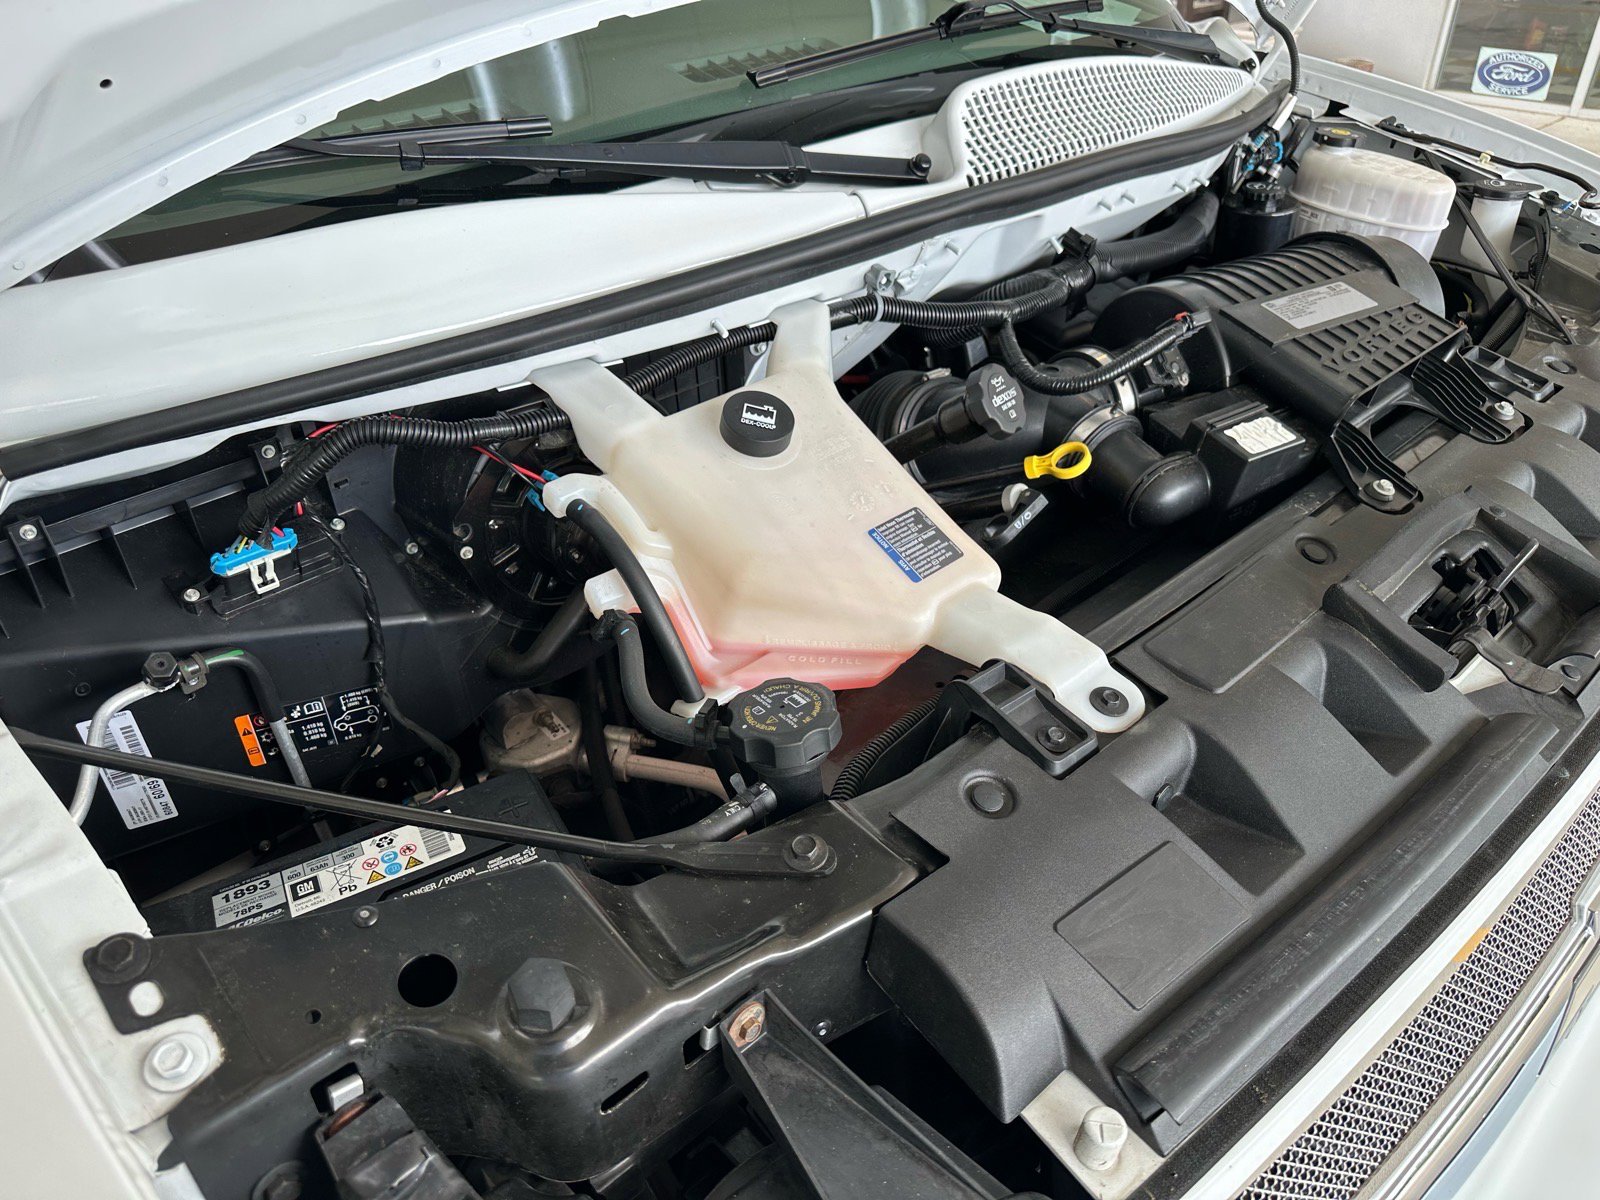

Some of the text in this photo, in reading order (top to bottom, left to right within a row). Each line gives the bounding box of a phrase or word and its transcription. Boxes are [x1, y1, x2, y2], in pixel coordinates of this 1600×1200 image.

[1488, 52, 1544, 70] AUTHORIZED
[1491, 64, 1534, 82] Ford
[1488, 82, 1529, 95] SERVICE
[1321, 308, 1427, 375] VORTEC
[992, 387, 1017, 408] dexos
[872, 532, 911, 572] AVIS NOTICE
[787, 654, 862, 665] COLD FILL
[756, 722, 776, 731] NEVER
[147, 780, 164, 800] 60/69
[342, 852, 354, 860] 300
[310, 862, 328, 872] 63Ah
[288, 872, 302, 880] 600
[402, 882, 438, 898] DANGER
[444, 867, 476, 884] POISON
[222, 880, 270, 903] 1893
[296, 880, 315, 896] GM
[338, 884, 358, 896] Pb
[234, 903, 263, 918] 78PS
